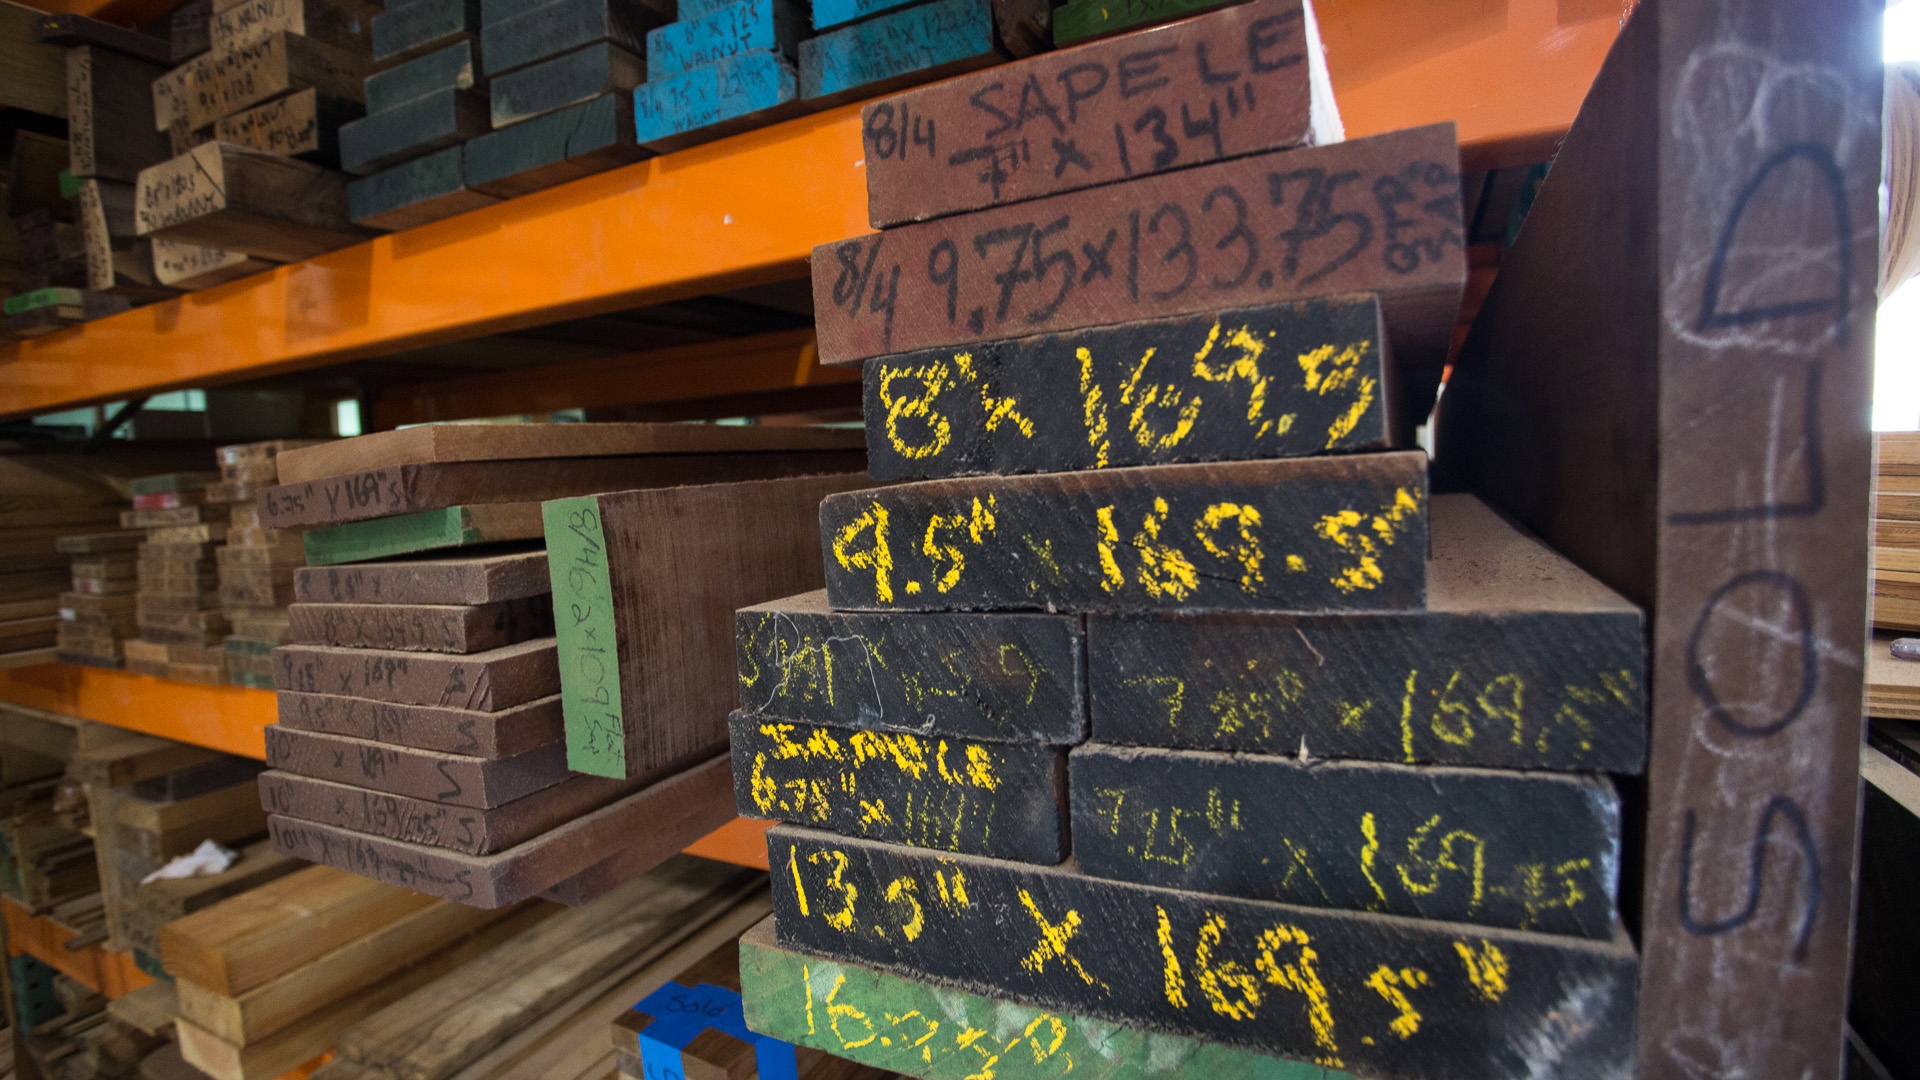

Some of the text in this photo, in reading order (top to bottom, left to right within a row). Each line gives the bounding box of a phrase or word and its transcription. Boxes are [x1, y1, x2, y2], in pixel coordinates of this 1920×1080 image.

[680, 33, 752, 71] WALNUT
[966, 7, 1305, 139] SAPELE
[862, 101, 937, 161] 8/4
[1113, 83, 1258, 177] 134"
[832, 237, 902, 357] 8/4
[832, 493, 998, 605] 9.5"
[1667, 141, 1852, 964] SOLD
[578, 646, 610, 708] 109
[1154, 904, 1513, 1070] 169.5"
